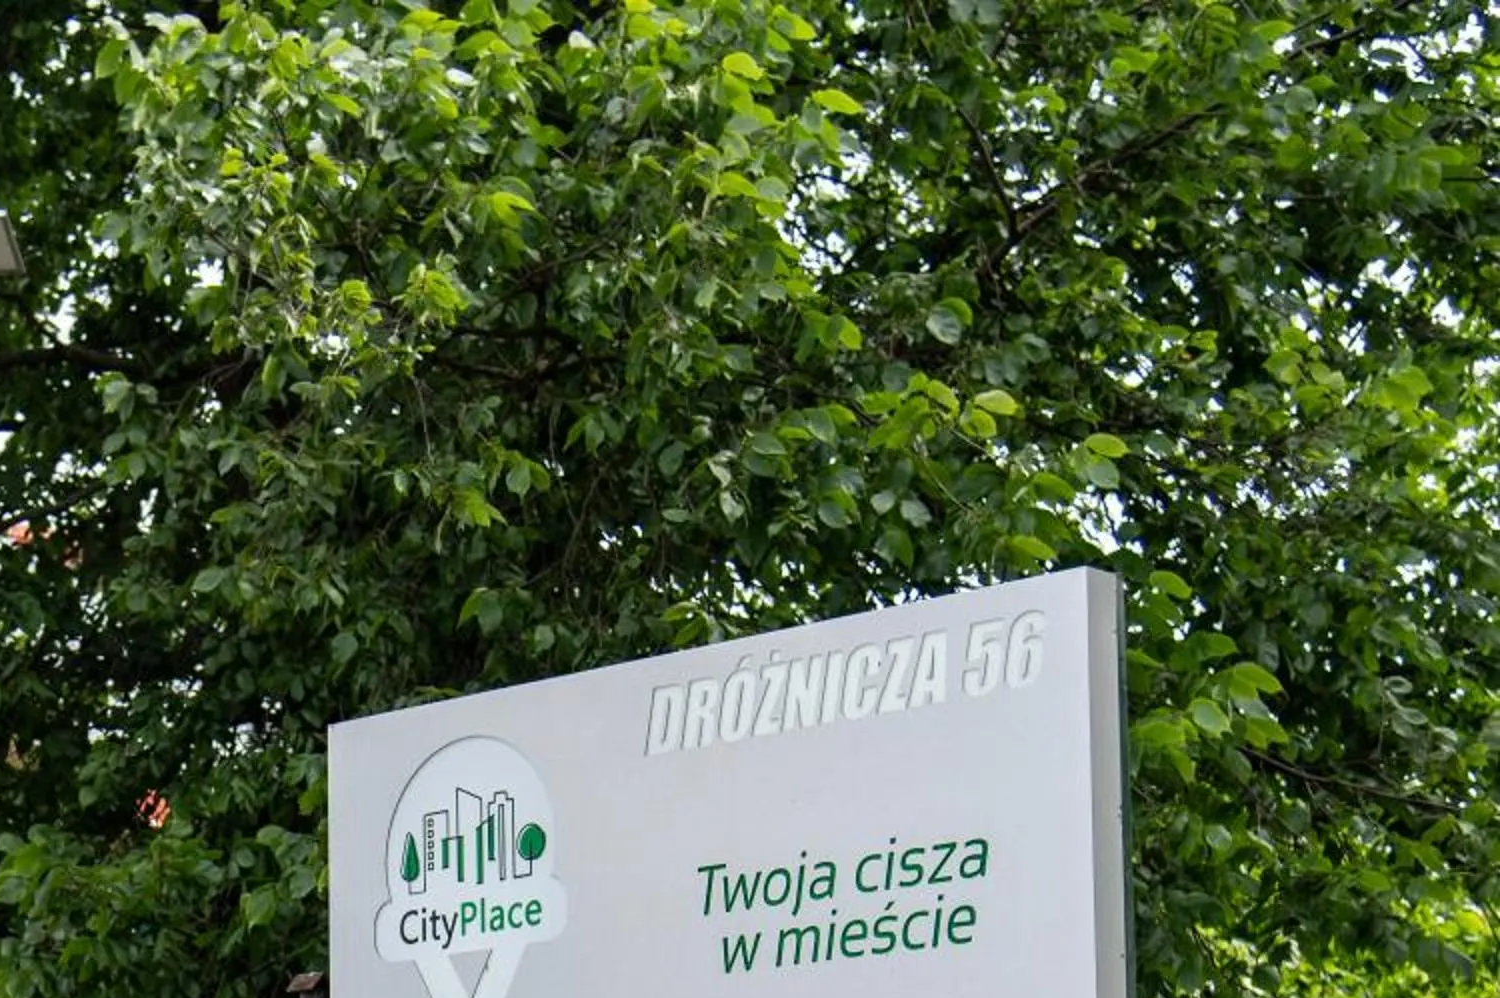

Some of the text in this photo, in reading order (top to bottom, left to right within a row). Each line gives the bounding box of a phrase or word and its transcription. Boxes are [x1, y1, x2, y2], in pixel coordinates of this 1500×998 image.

[644, 610, 1046, 758] DRÓŻNICZA 56
[697, 836, 990, 917] Twoja cisza
[722, 893, 977, 974] w mieście
